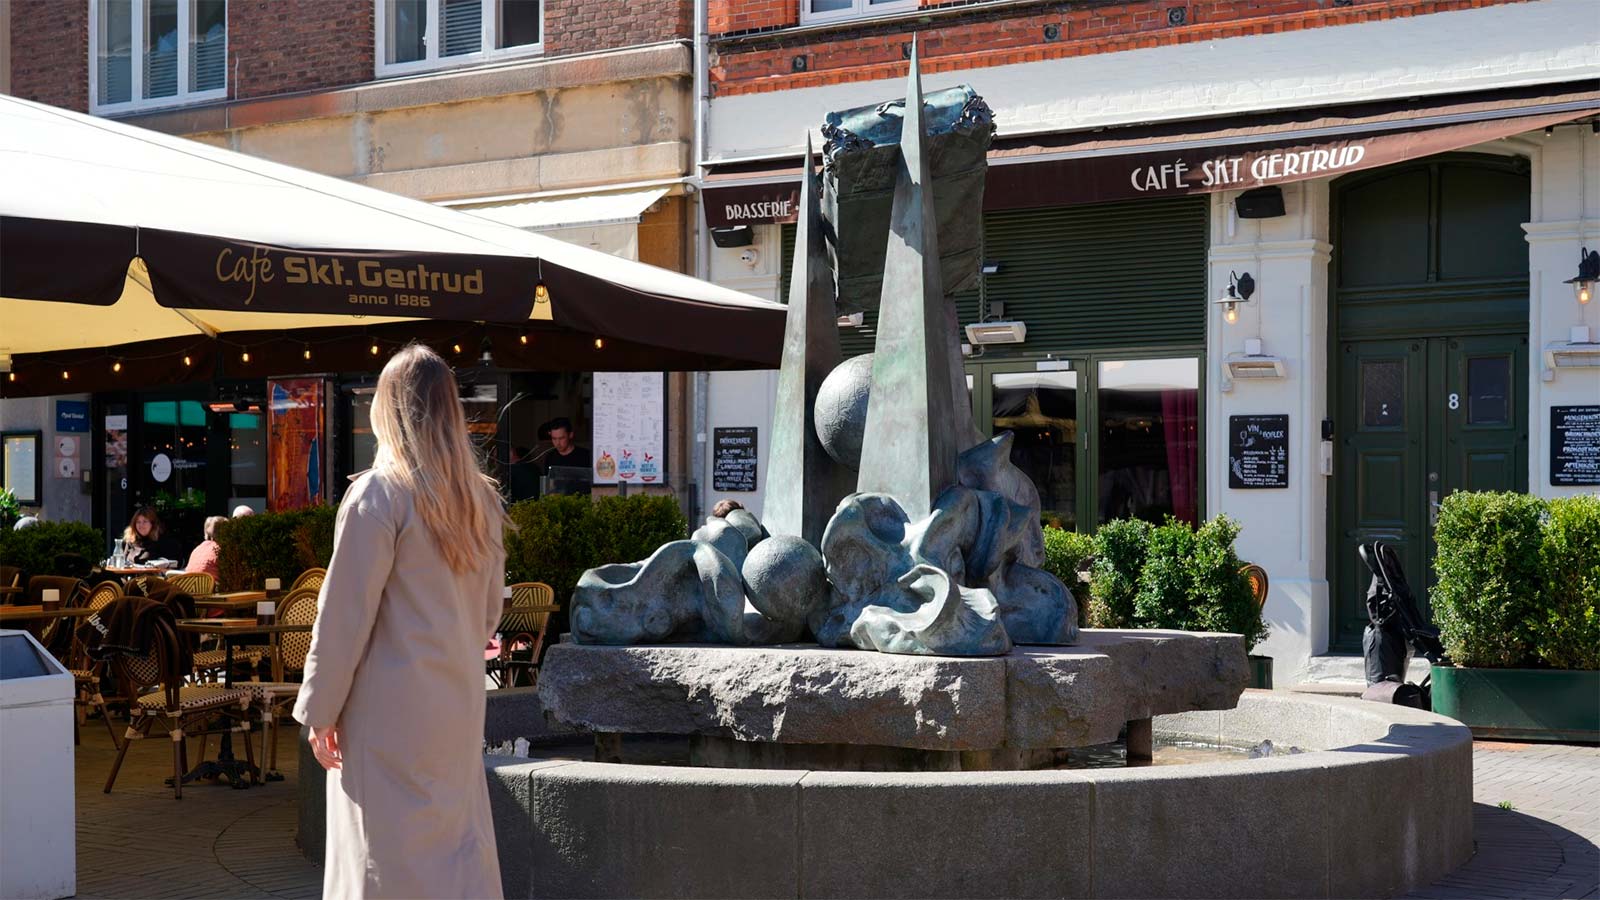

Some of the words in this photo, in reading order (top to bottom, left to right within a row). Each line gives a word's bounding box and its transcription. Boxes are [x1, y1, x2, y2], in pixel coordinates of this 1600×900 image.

[1130, 158, 1190, 192] CAFÉ
[1201, 157, 1244, 187] SKT.
[1250, 145, 1365, 181] GERTRUD
[725, 200, 792, 220] BRASSERIE
[215, 247, 275, 305] Café
[283, 256, 353, 287] Skt.
[358, 260, 485, 295] Gertrud
[348, 294, 388, 306] anno
[395, 294, 432, 308] 1986
[1448, 393, 1459, 410] 8
[120, 478, 127, 490] 6
